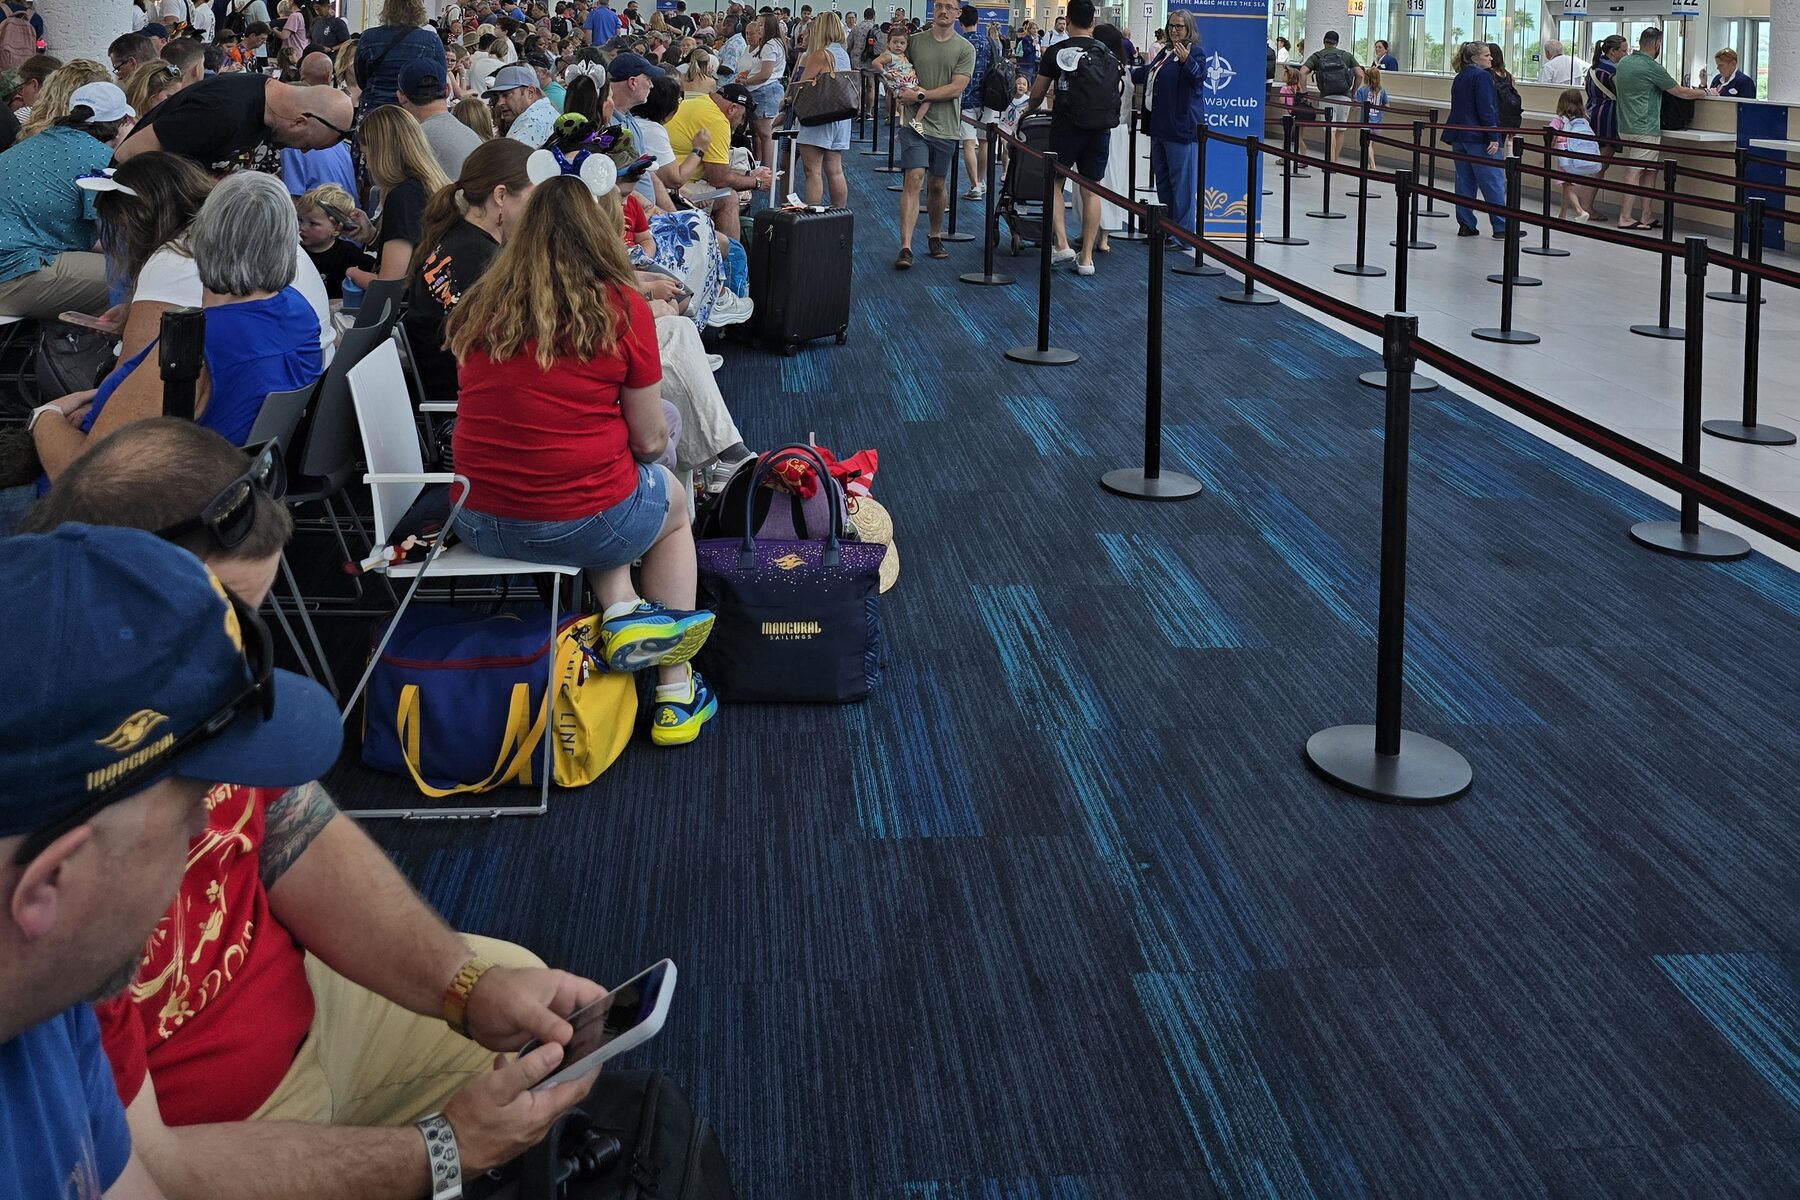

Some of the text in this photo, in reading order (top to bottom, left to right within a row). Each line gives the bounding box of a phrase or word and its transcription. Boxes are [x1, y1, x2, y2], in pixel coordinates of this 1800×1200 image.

[1146, 6, 1153, 14] 13
[1277, 3, 1285, 11] 17
[1354, 1, 1363, 11] 18
[1414, 0, 1424, 10] 19
[1203, 96, 1258, 109] wayclub
[761, 621, 822, 635] INAUGURAL
